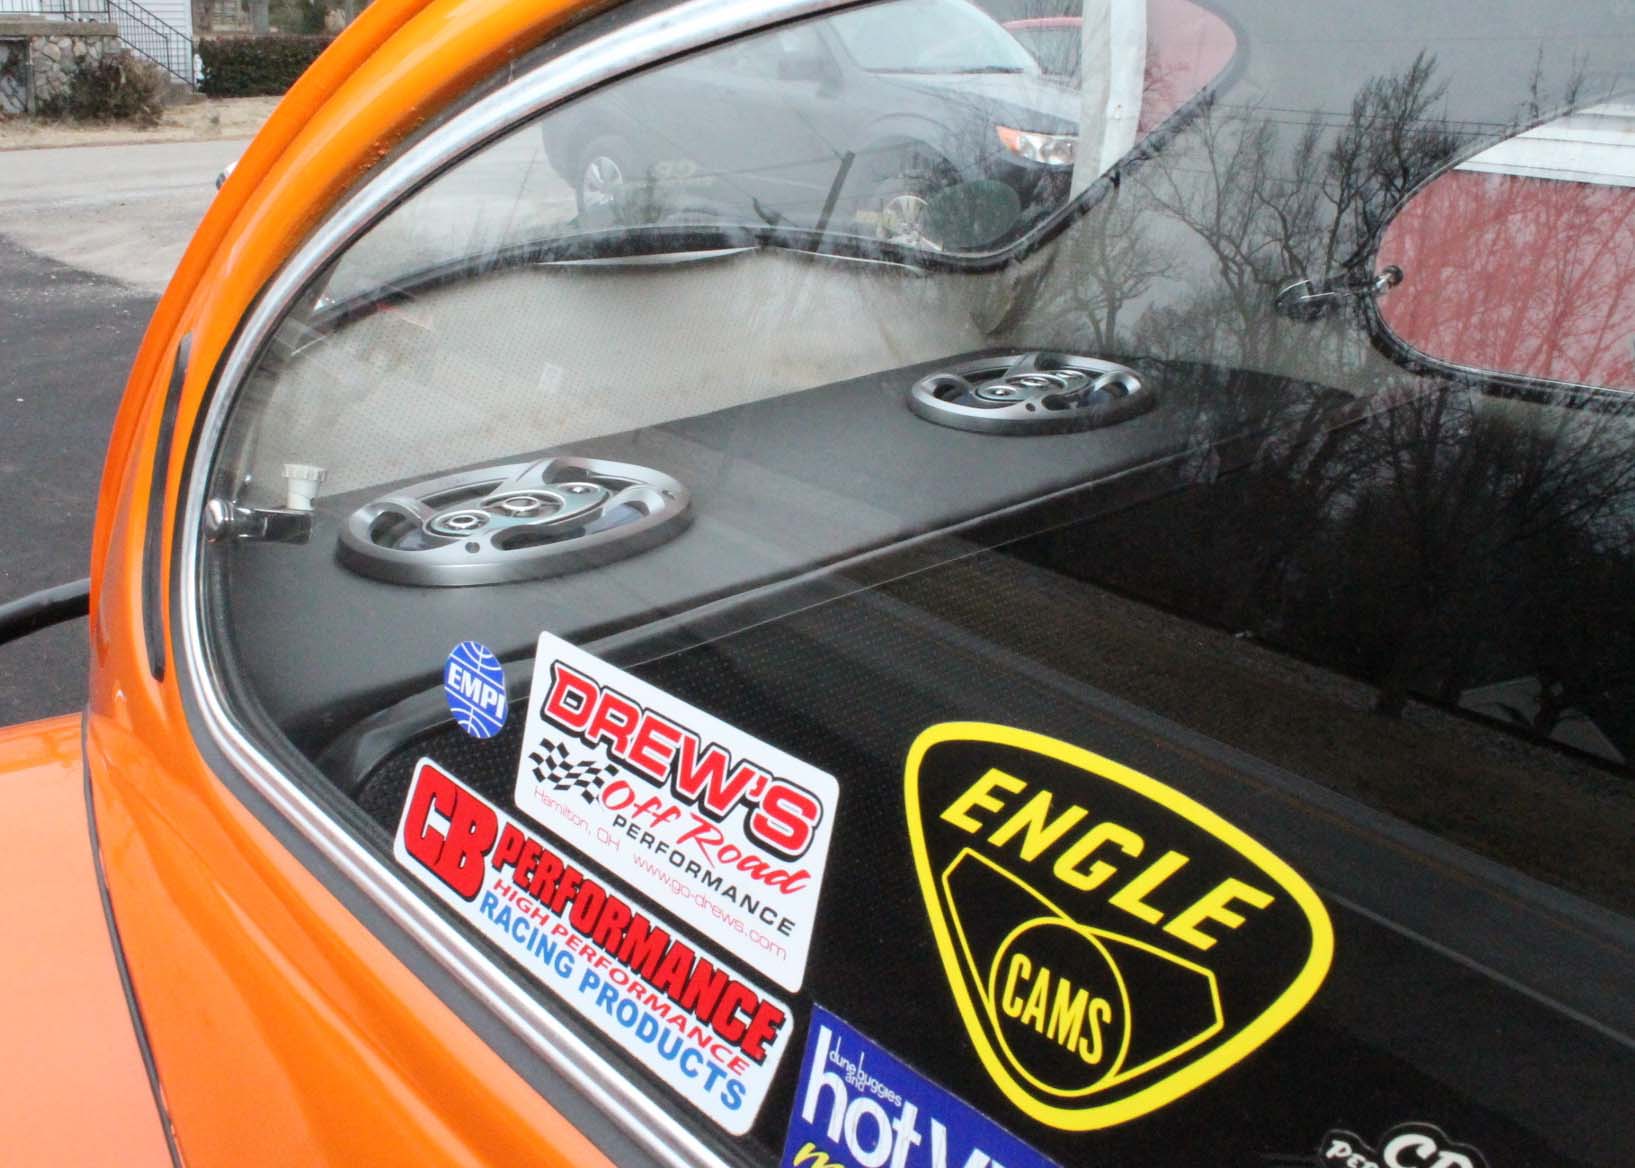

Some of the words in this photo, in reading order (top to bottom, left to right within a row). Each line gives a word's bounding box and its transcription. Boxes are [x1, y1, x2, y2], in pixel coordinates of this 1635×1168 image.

[448, 662, 506, 719] EMPI
[541, 660, 823, 862] DREW'S
[597, 828, 621, 851] OH
[601, 780, 680, 828] Off
[676, 812, 811, 894] Road
[612, 814, 796, 936] PERFORMANCE
[939, 767, 1276, 951] ENGLE
[403, 764, 498, 901] CB
[491, 822, 786, 1066] PERFORMANCE
[493, 878, 548, 926] HIGH
[551, 924, 751, 1076] PERFORMANCE
[479, 890, 575, 979] RACING
[579, 968, 747, 1111] PRODUCTS
[1002, 953, 1112, 1064] CAMS
[802, 1024, 922, 1168] hot
